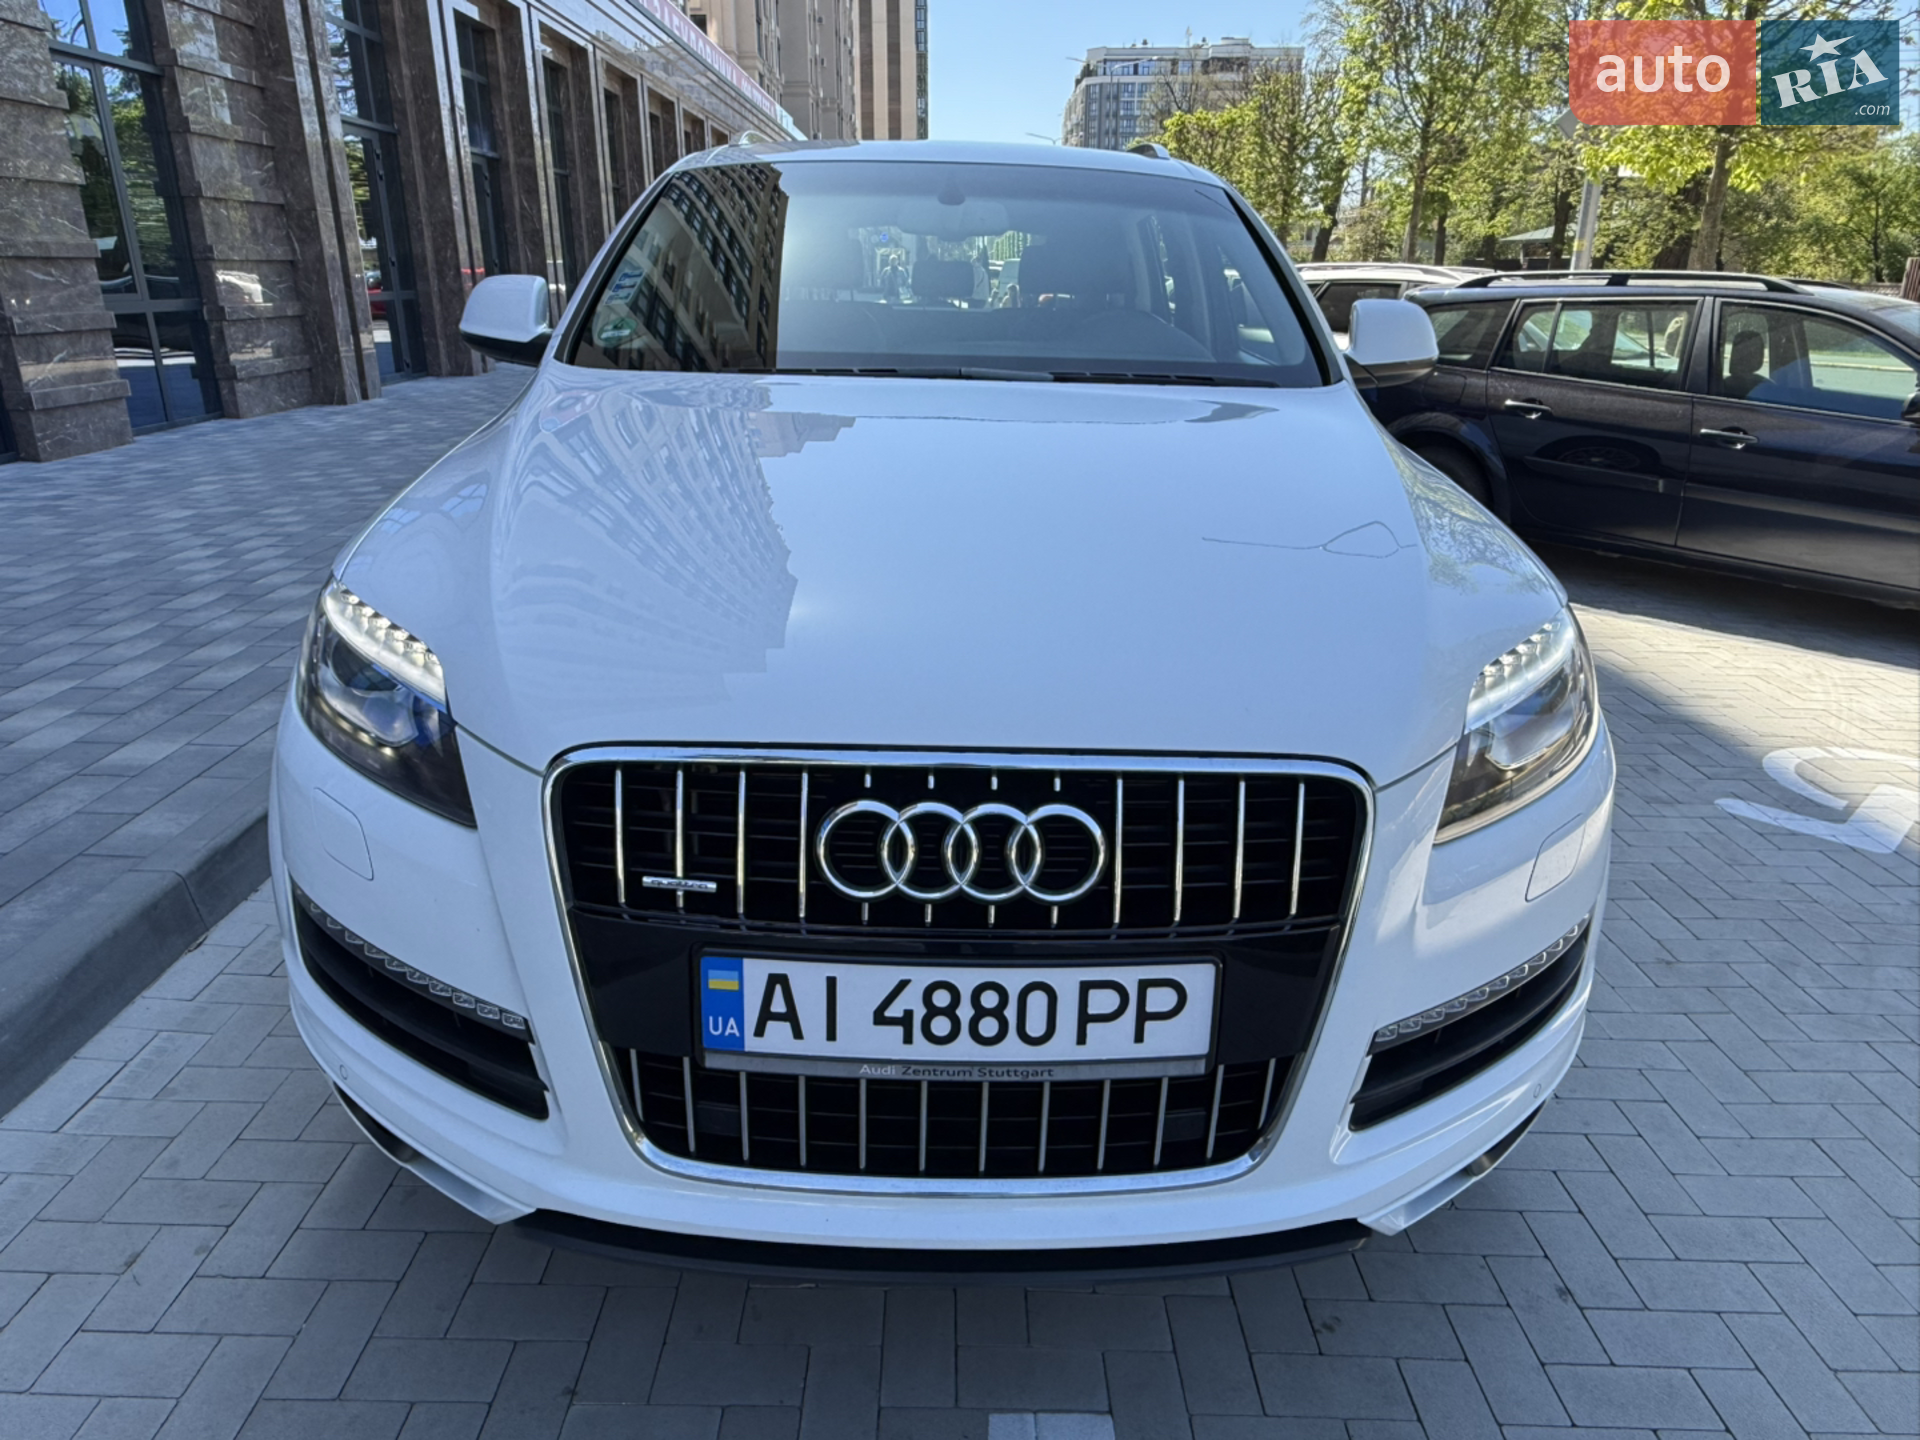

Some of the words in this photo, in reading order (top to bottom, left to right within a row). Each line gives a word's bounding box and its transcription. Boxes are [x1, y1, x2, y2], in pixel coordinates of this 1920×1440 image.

[753, 973, 837, 1042] AI
[873, 979, 1059, 1047] 4880
[1076, 978, 1188, 1046] PP
[708, 1016, 740, 1037] UA
[859, 1064, 896, 1076] Audi
[901, 1065, 972, 1078] Zentrum
[977, 1067, 1054, 1080] Stuttgart
